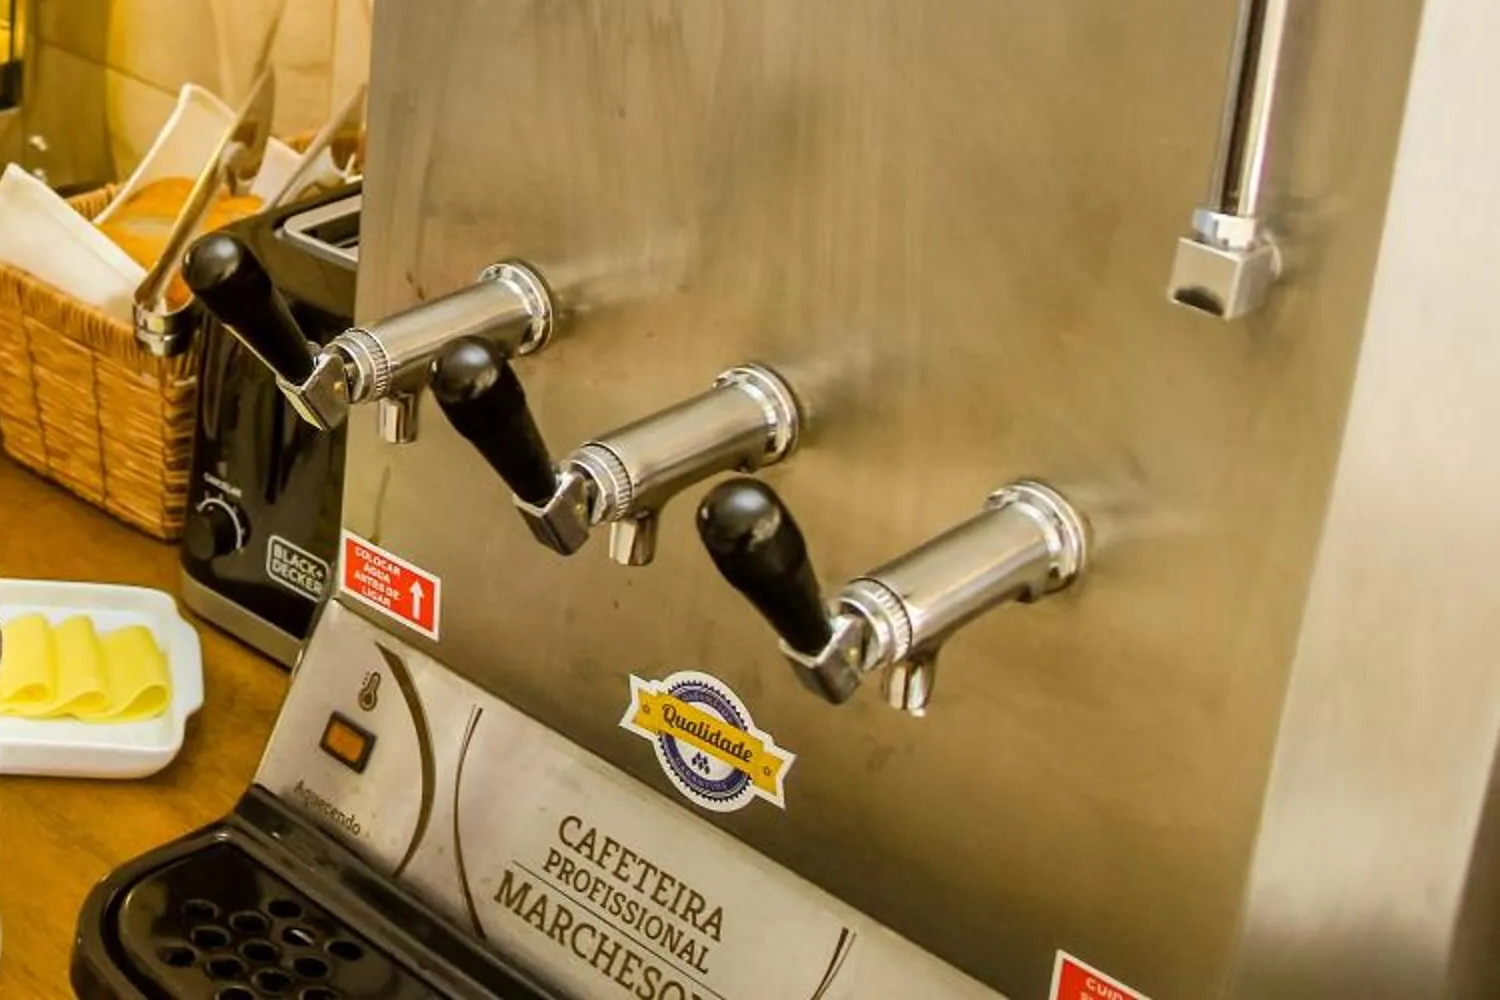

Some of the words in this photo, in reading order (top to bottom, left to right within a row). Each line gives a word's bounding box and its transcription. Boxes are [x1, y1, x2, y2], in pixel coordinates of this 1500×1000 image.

[271, 558, 325, 595] DECKER
[354, 569, 385, 592] ANTES
[385, 586, 401, 600] DE
[355, 546, 401, 576] COLOCAR
[661, 703, 754, 763] Qualidade
[293, 779, 361, 836] Aquecendo
[557, 815, 724, 943] CAFETEIRA
[493, 869, 704, 1000] MARCHESO
[541, 846, 709, 975] PROFISSIONAL
